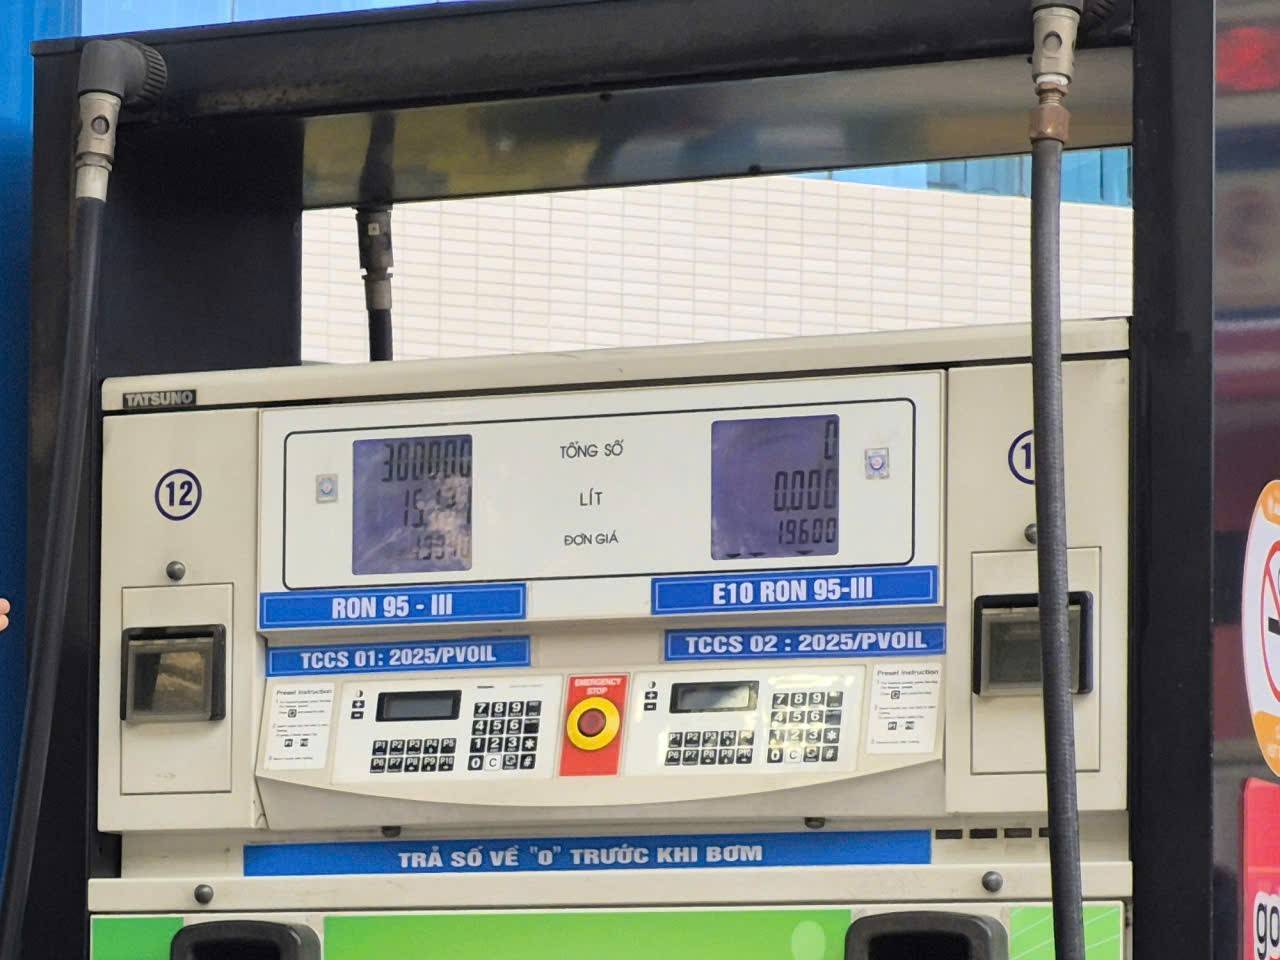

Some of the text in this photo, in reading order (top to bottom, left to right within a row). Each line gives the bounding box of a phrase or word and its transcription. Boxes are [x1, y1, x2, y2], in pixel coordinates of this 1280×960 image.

[125, 390, 193, 407] TATSUNO
[824, 419, 838, 460] 0
[560, 439, 624, 459] TỔNG SỐ
[1020, 442, 1032, 470] 1
[381, 440, 472, 482] 300000
[165, 480, 193, 507] 12
[580, 487, 603, 506] LÍT
[564, 529, 619, 546] ĐƠN GIÁ
[778, 517, 837, 545] 19600
[713, 577, 873, 605] E10 RON 95-III
[332, 596, 377, 619] RON
[383, 595, 409, 617] 95
[431, 594, 453, 616] III
[686, 636, 743, 654] TCCS
[750, 635, 776, 652] 02
[798, 630, 927, 651] 2025/PVOIL
[301, 645, 497, 669] TCCS 01: 2025/PVOIL
[586, 687, 608, 695] STOP
[776, 693, 786, 705] 7
[794, 693, 803, 704] 8
[812, 693, 821, 704] 9
[477, 703, 487, 714] 7
[494, 702, 504, 713] 8
[512, 702, 521, 712] 9
[774, 711, 820, 722] 4 5 6
[475, 721, 484, 730] 4
[493, 720, 502, 730] 5
[510, 719, 519, 730] 6
[791, 729, 801, 740] 2
[809, 728, 818, 739] 3
[376, 741, 386, 749] P1
[392, 741, 403, 749] P2
[443, 739, 454, 747] P5
[474, 737, 517, 749] 1 2 3
[390, 758, 401, 766] P7
[471, 757, 480, 769] 0
[489, 758, 497, 767] C
[771, 749, 780, 761] 0
[398, 845, 443, 868] TRẢ
[451, 845, 483, 867] SỐ
[489, 845, 519, 866] VỀ
[570, 843, 650, 865] TRƯỚC
[657, 847, 699, 864] KHI
[706, 845, 763, 863] BƠM
